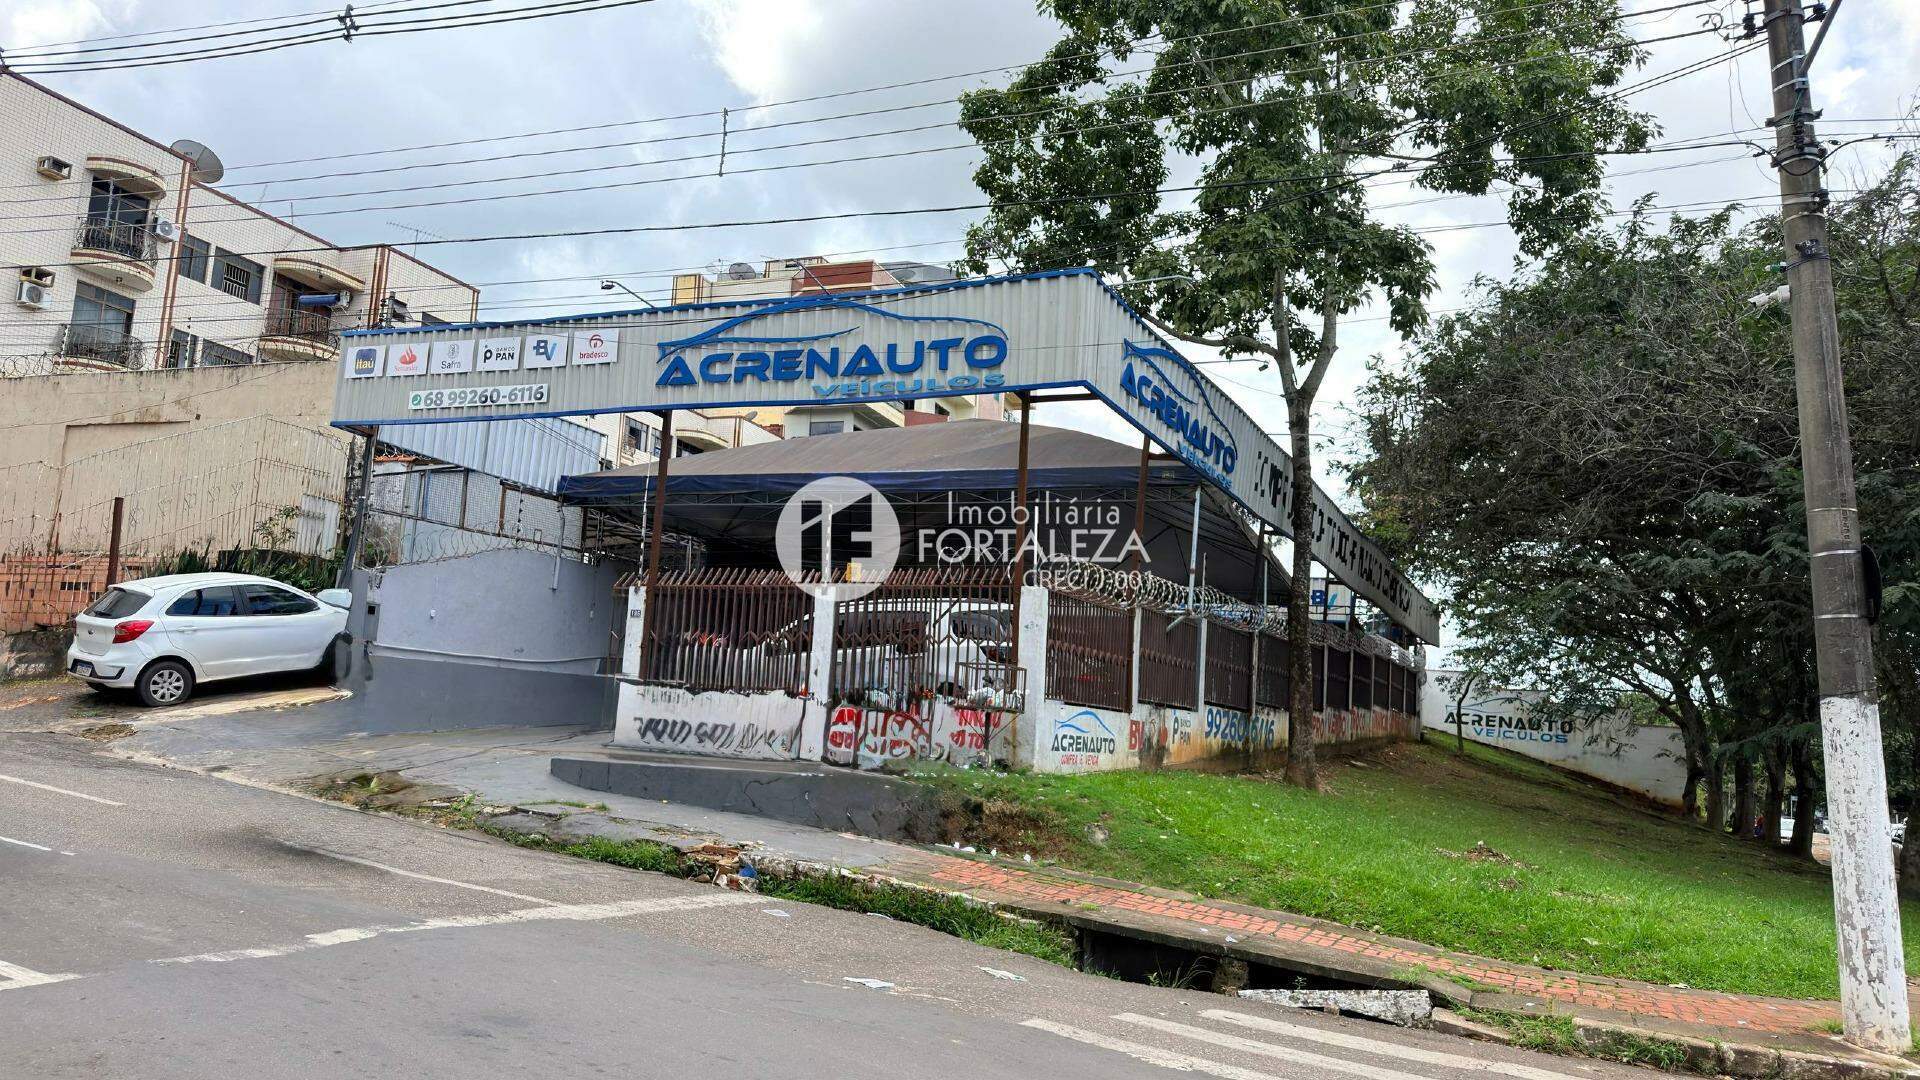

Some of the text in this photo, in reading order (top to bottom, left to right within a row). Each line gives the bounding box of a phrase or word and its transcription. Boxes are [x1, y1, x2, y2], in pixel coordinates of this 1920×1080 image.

[495, 352, 515, 361] PAN
[533, 340, 557, 360] BV
[579, 351, 608, 359] bradesco
[655, 335, 1008, 386] ACRENAUTO
[423, 385, 544, 406] 68 99260-6116
[1120, 362, 1236, 474] ACRENAUTO
[1444, 712, 1574, 734] ACRENAUTO
[1051, 734, 1116, 754] ACRENAUTO
